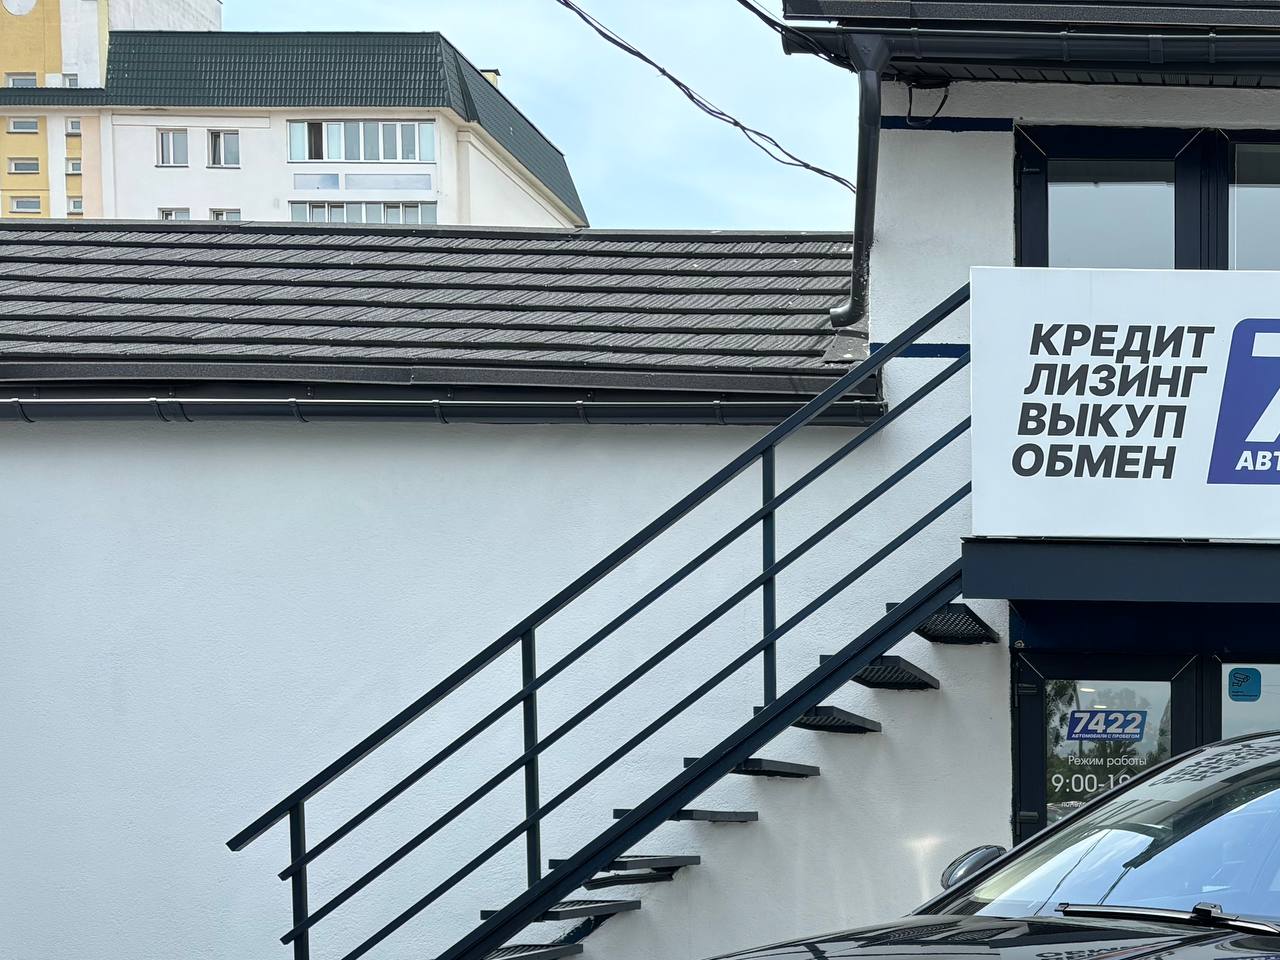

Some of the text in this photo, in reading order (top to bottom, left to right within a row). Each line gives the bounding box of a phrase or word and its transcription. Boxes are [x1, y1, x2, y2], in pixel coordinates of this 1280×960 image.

[1029, 323, 1216, 364] КРЕДИТ
[1023, 363, 1208, 398] ЛИЗИНГ
[1017, 402, 1187, 439] ВЫКУП
[1011, 443, 1177, 480] ОБМЕН
[1073, 712, 1143, 734] 7422
[1068, 754, 1147, 767] Режим работы
